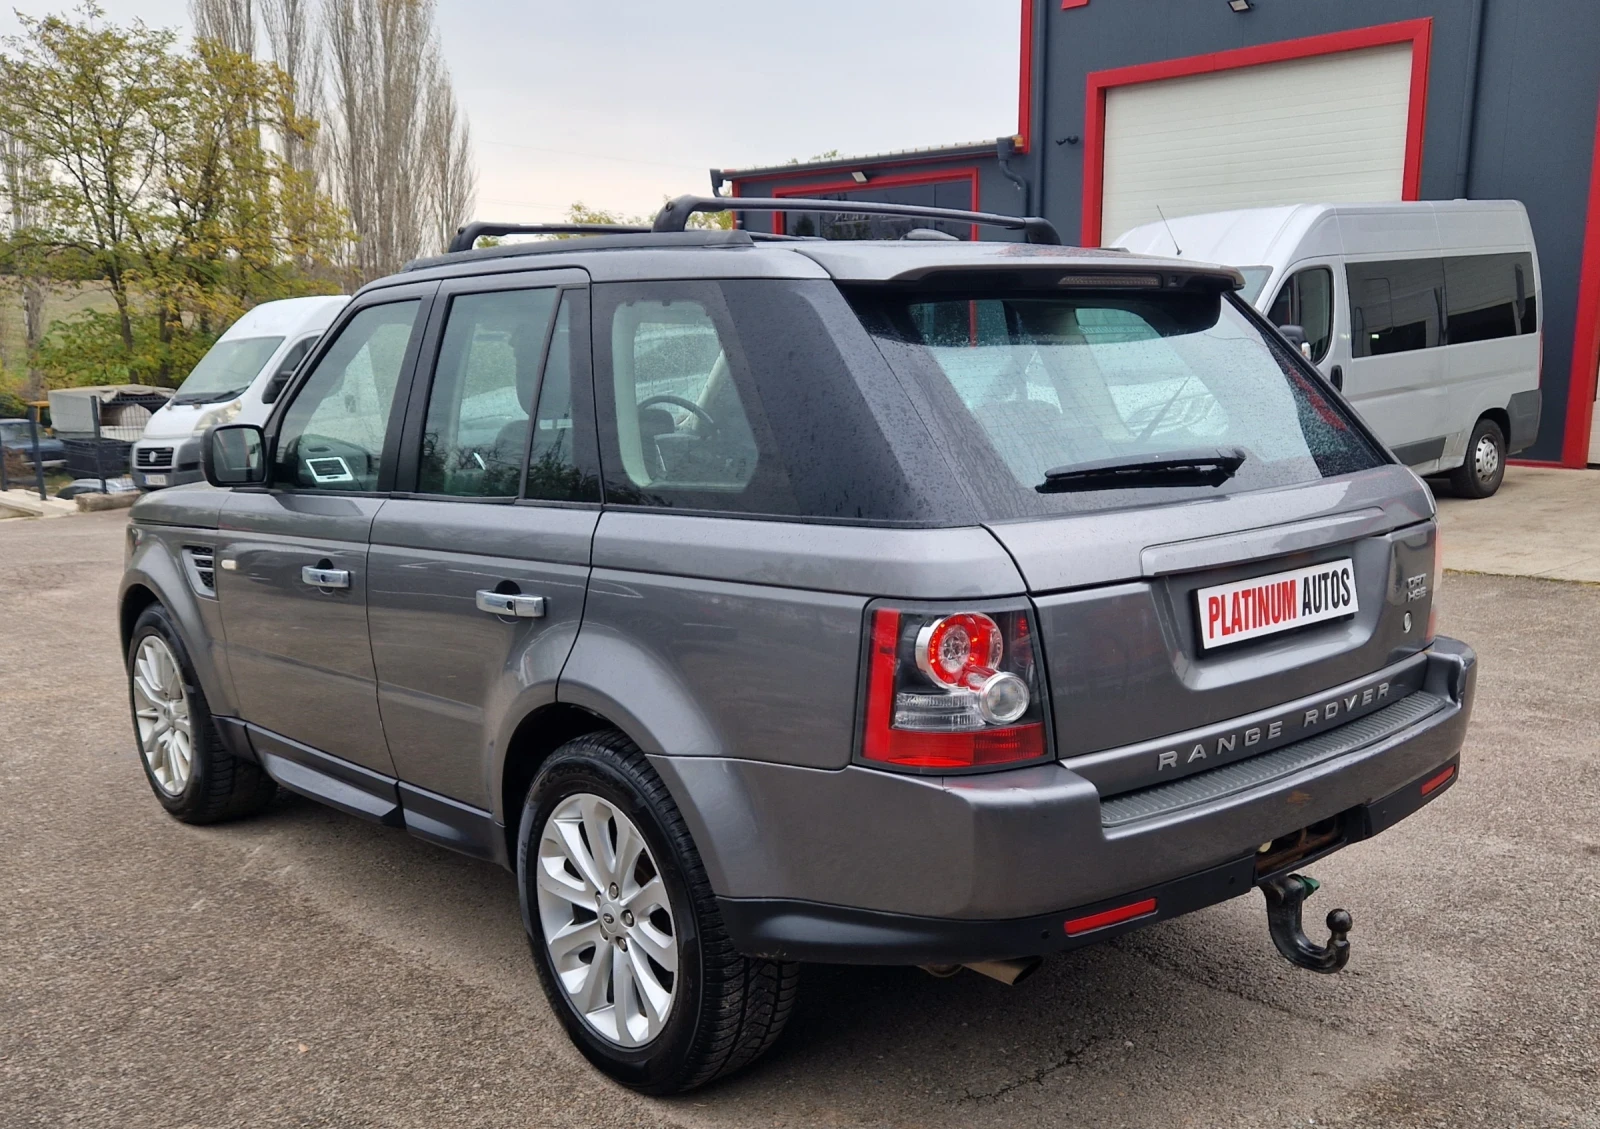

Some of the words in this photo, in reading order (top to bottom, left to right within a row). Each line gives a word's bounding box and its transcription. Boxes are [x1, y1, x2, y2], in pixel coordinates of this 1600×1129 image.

[1208, 579, 1297, 639] PLATINUM
[1302, 567, 1351, 616] AUTOS
[1407, 586, 1427, 603] HSE
[1157, 721, 1283, 771] RANGE
[1303, 682, 1390, 727] ROVER
